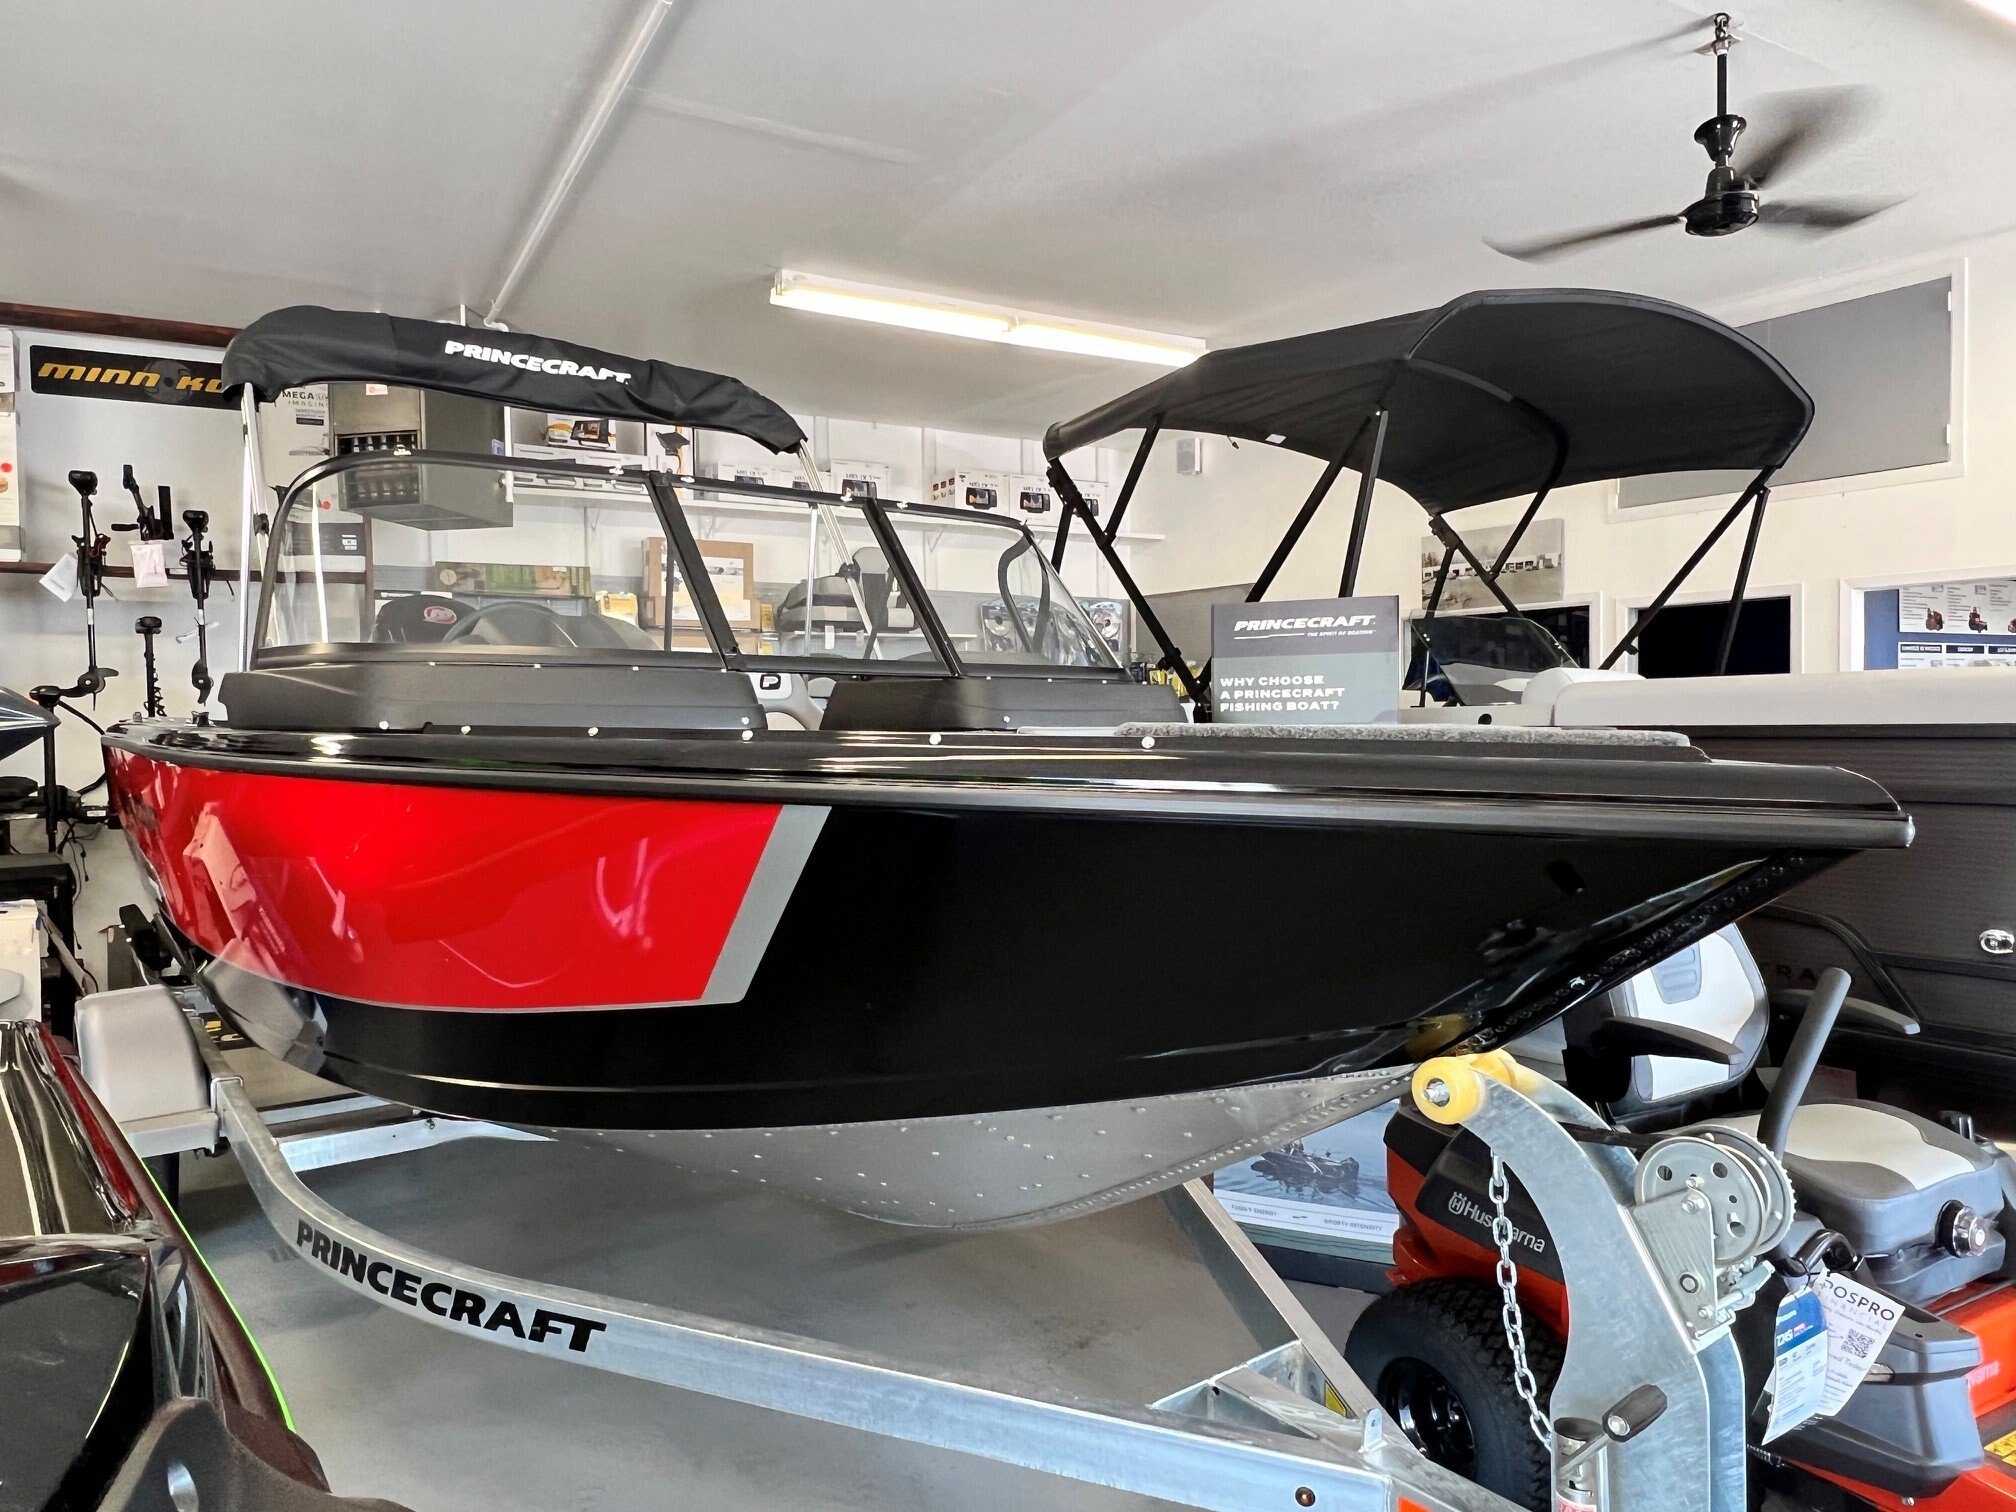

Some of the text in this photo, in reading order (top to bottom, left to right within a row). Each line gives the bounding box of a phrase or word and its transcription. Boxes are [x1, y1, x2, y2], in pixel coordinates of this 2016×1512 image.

[444, 340, 632, 385] PRINCECRAFT
[175, 376, 223, 393] KO
[281, 390, 315, 400] MEGA
[1233, 614, 1376, 632] PRINCECRAFT
[1219, 675, 1325, 687] WHY CHOOSE
[1219, 687, 1346, 700] A PRINCECRAFT
[1219, 700, 1340, 713] FISHING BOAT?
[1463, 1201, 1546, 1253] Husarna
[296, 1218, 607, 1353] PRINCECRAFT
